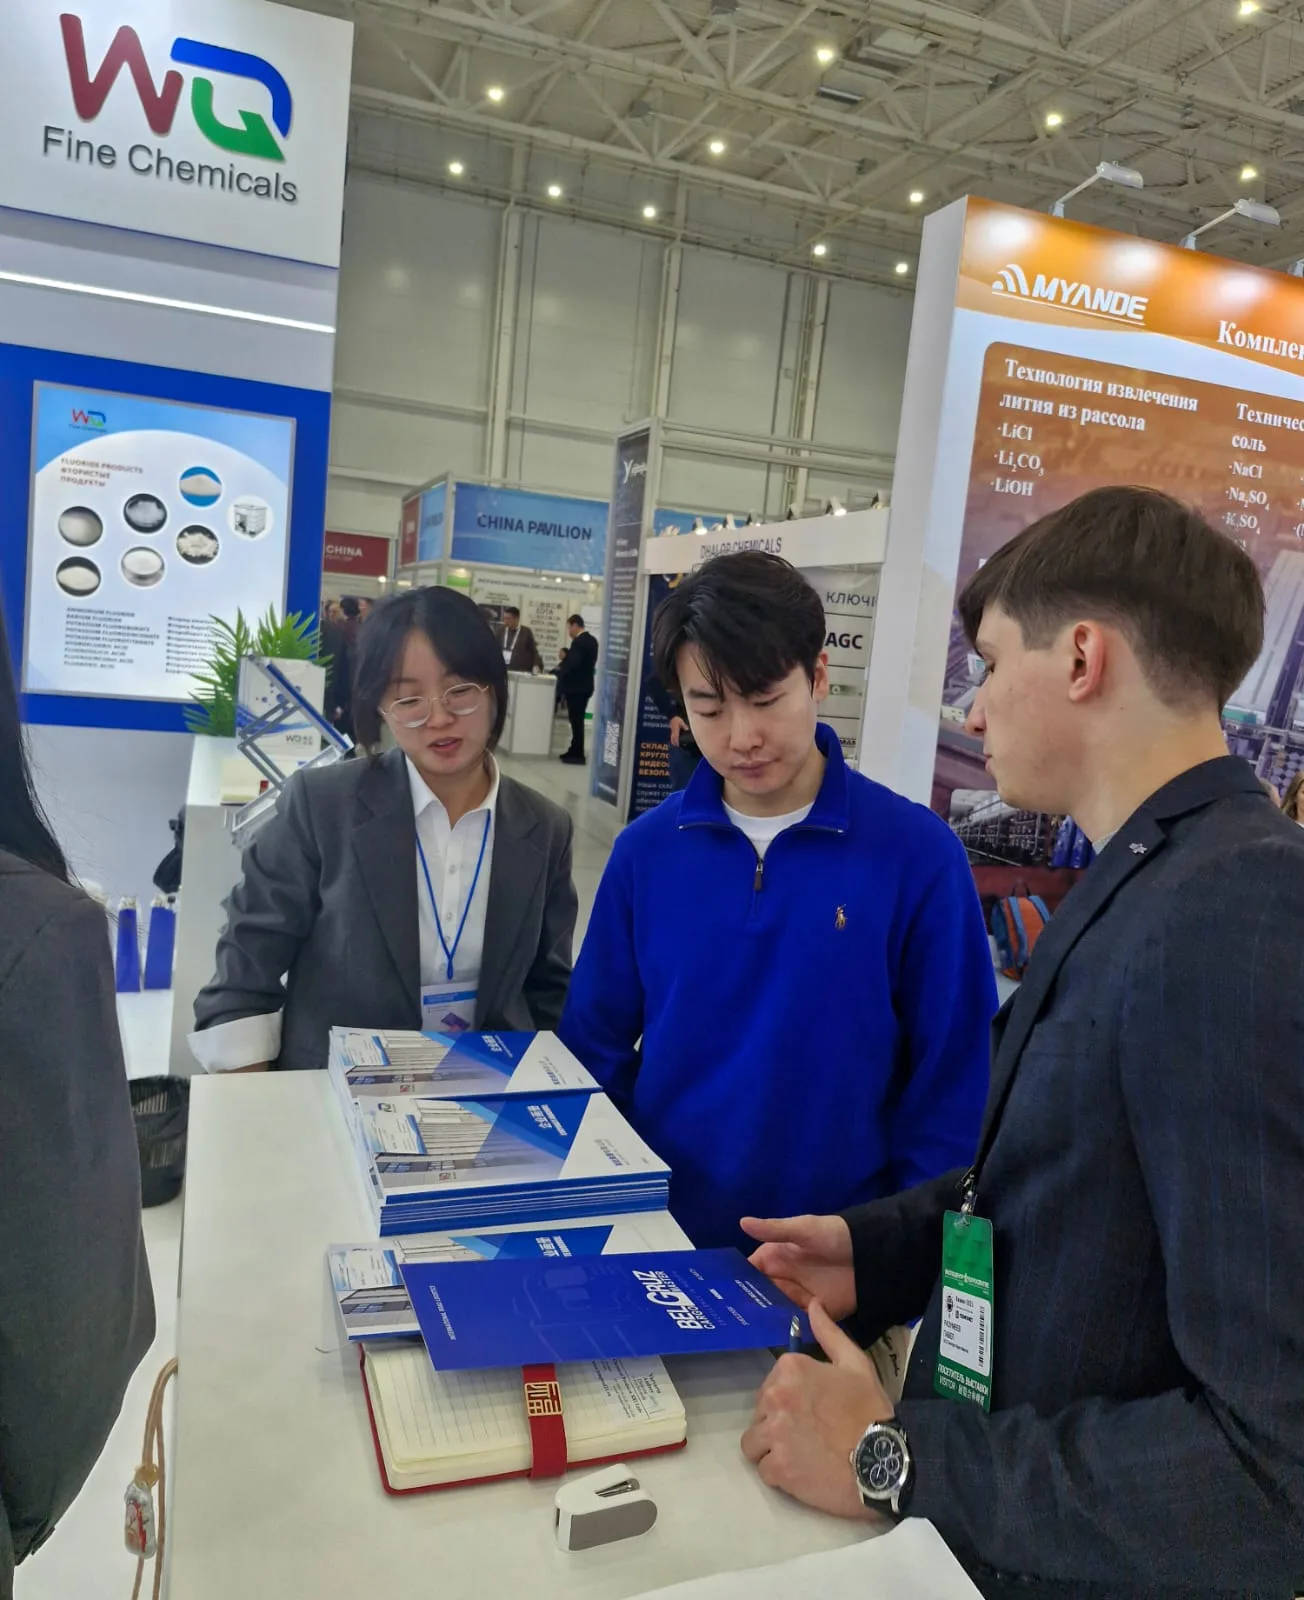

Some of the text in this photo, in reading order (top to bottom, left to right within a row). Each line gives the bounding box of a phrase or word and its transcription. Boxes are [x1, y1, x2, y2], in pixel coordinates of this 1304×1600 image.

[43, 125, 298, 203] Fine Chemicals
[1032, 273, 1149, 321] MYANDE
[1004, 357, 1199, 412] Технология извлечения
[999, 393, 1146, 431] лития из рассола
[1231, 434, 1267, 452] соль
[477, 514, 592, 540] CHINA PAVILION
[326, 544, 363, 557] CHINA
[733, 537, 782, 553] CHEMICALS
[825, 632, 864, 650] AGC
[632, 1270, 703, 1330] BELGRUZ
[688, 1306, 716, 1330] CARGO
